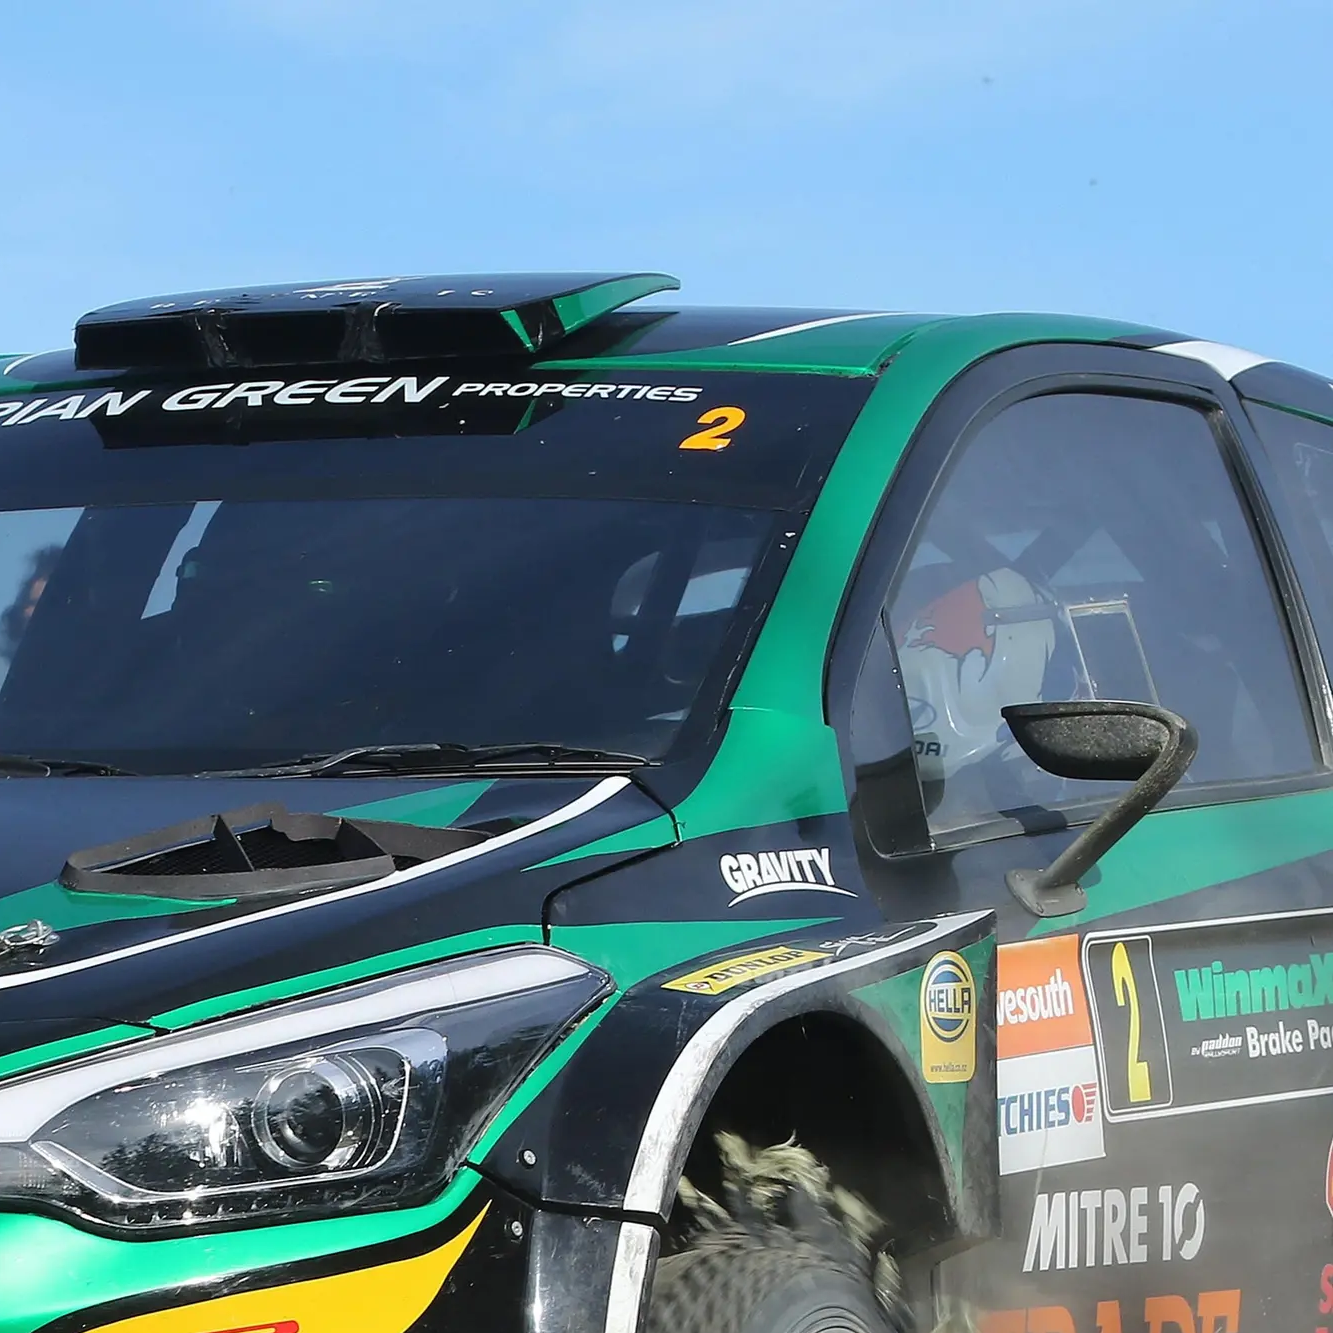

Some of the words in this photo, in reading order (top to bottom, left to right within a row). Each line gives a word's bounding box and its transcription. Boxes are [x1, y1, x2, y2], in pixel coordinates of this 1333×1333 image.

[162, 376, 453, 412] GREEN
[452, 382, 703, 403] PROPERTIES
[679, 406, 746, 452] 2
[719, 847, 837, 894] GRAVITY
[712, 949, 805, 982] DUNLOP
[929, 987, 971, 1014] HELLA
[1110, 941, 1152, 1103] 2
[1245, 1020, 1303, 1058] Brake
[1022, 1185, 1149, 1273] MITRE
[1158, 1182, 1207, 1261] 10
